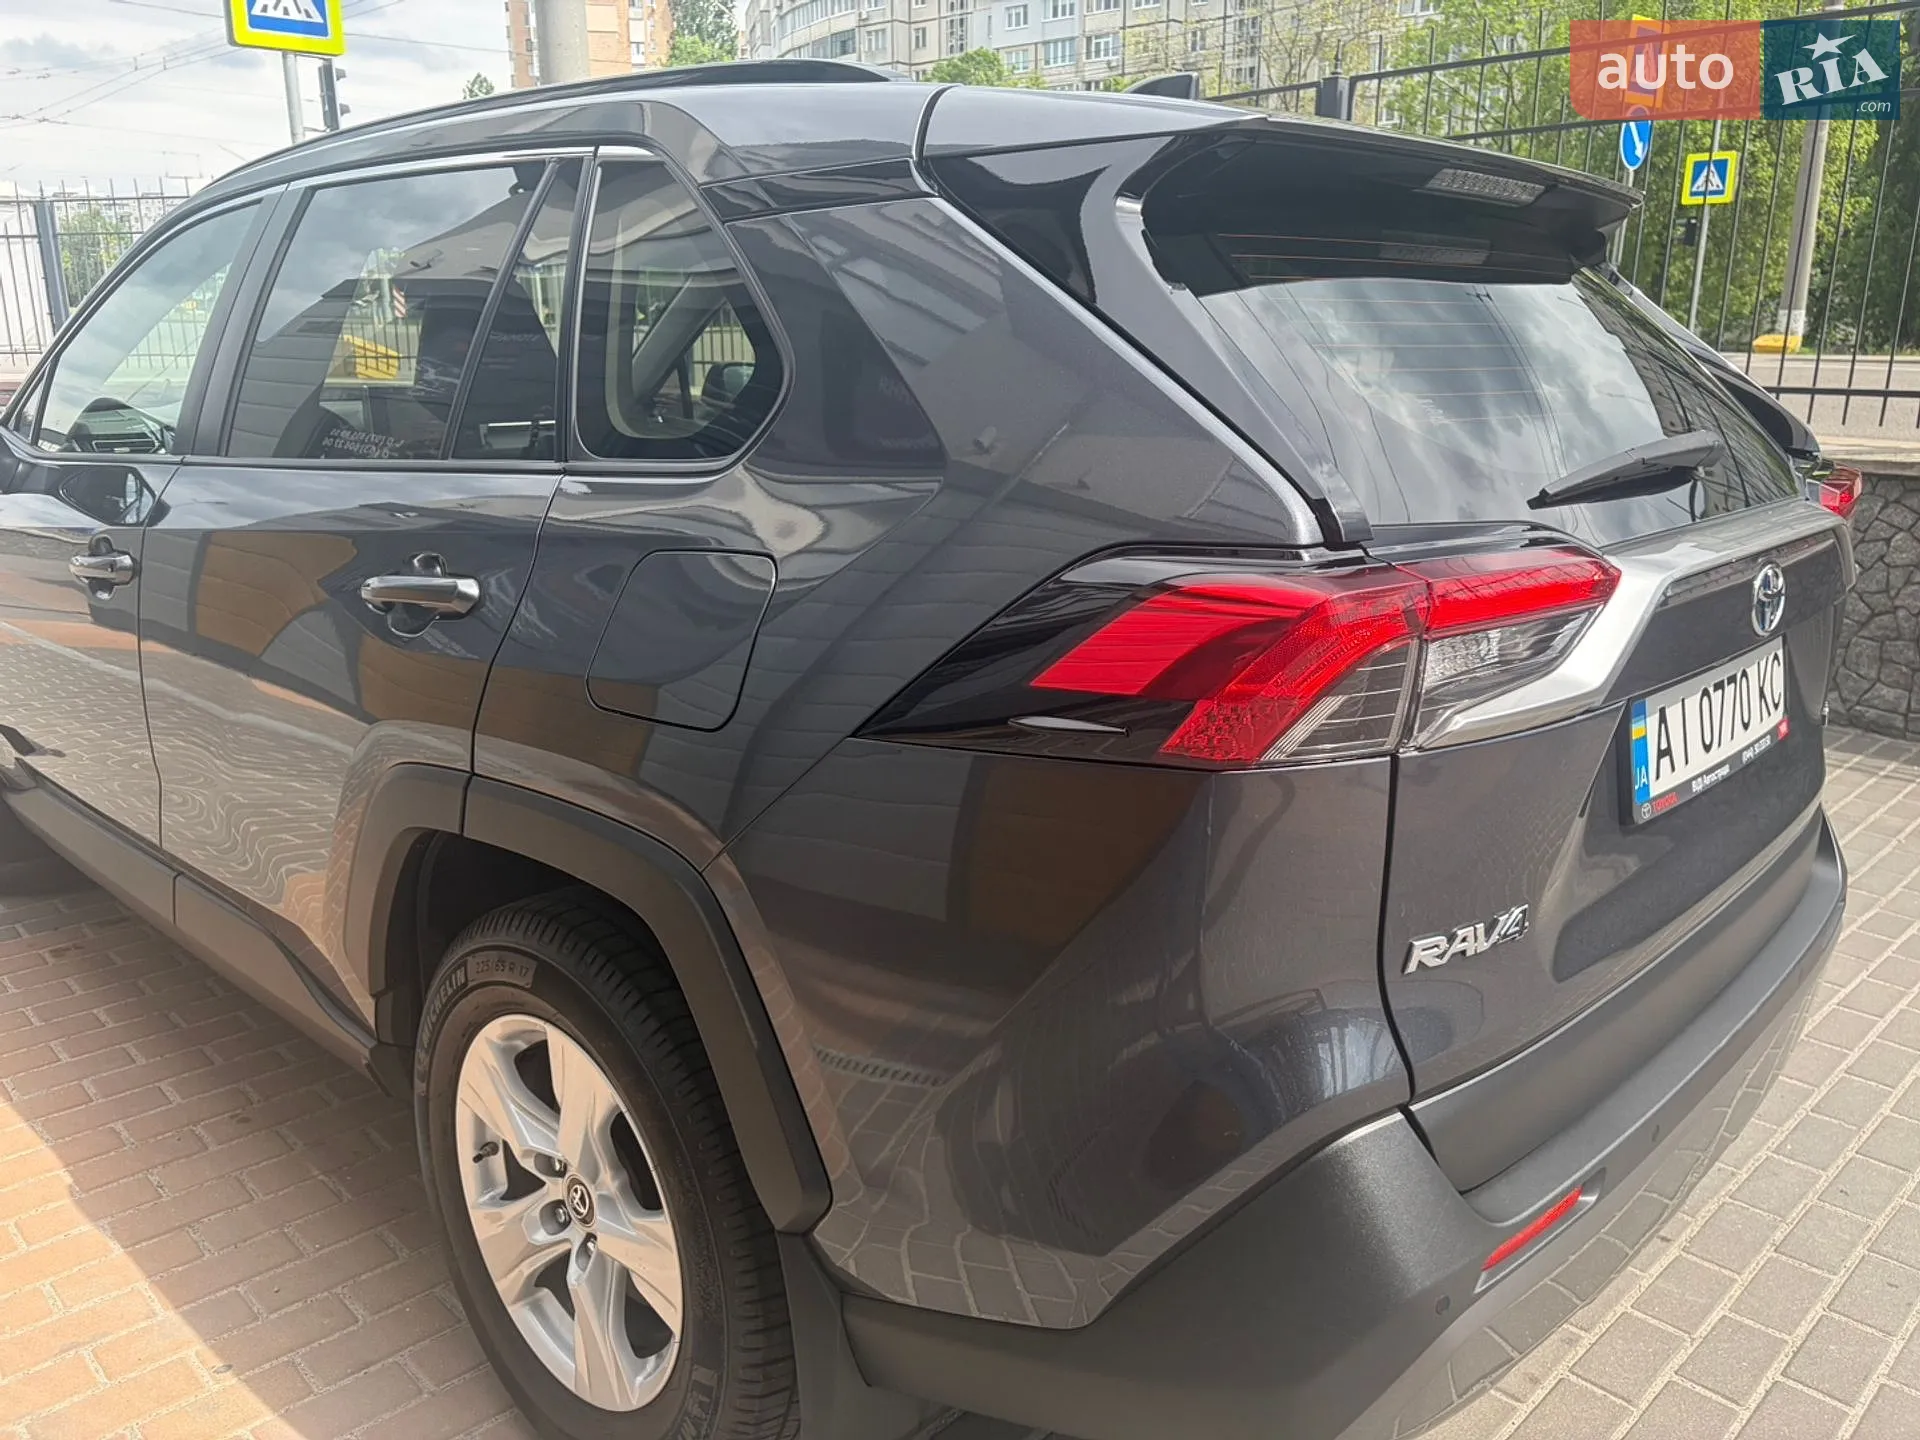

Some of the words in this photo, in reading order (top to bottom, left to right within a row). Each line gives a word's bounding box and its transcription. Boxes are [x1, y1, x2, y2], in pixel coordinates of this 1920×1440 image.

[1655, 697, 1689, 781] AI
[1699, 667, 1751, 753] 0770
[1757, 652, 1782, 723] KC
[1402, 904, 1529, 975] RAV4
[422, 965, 467, 1049] MICHELIN
